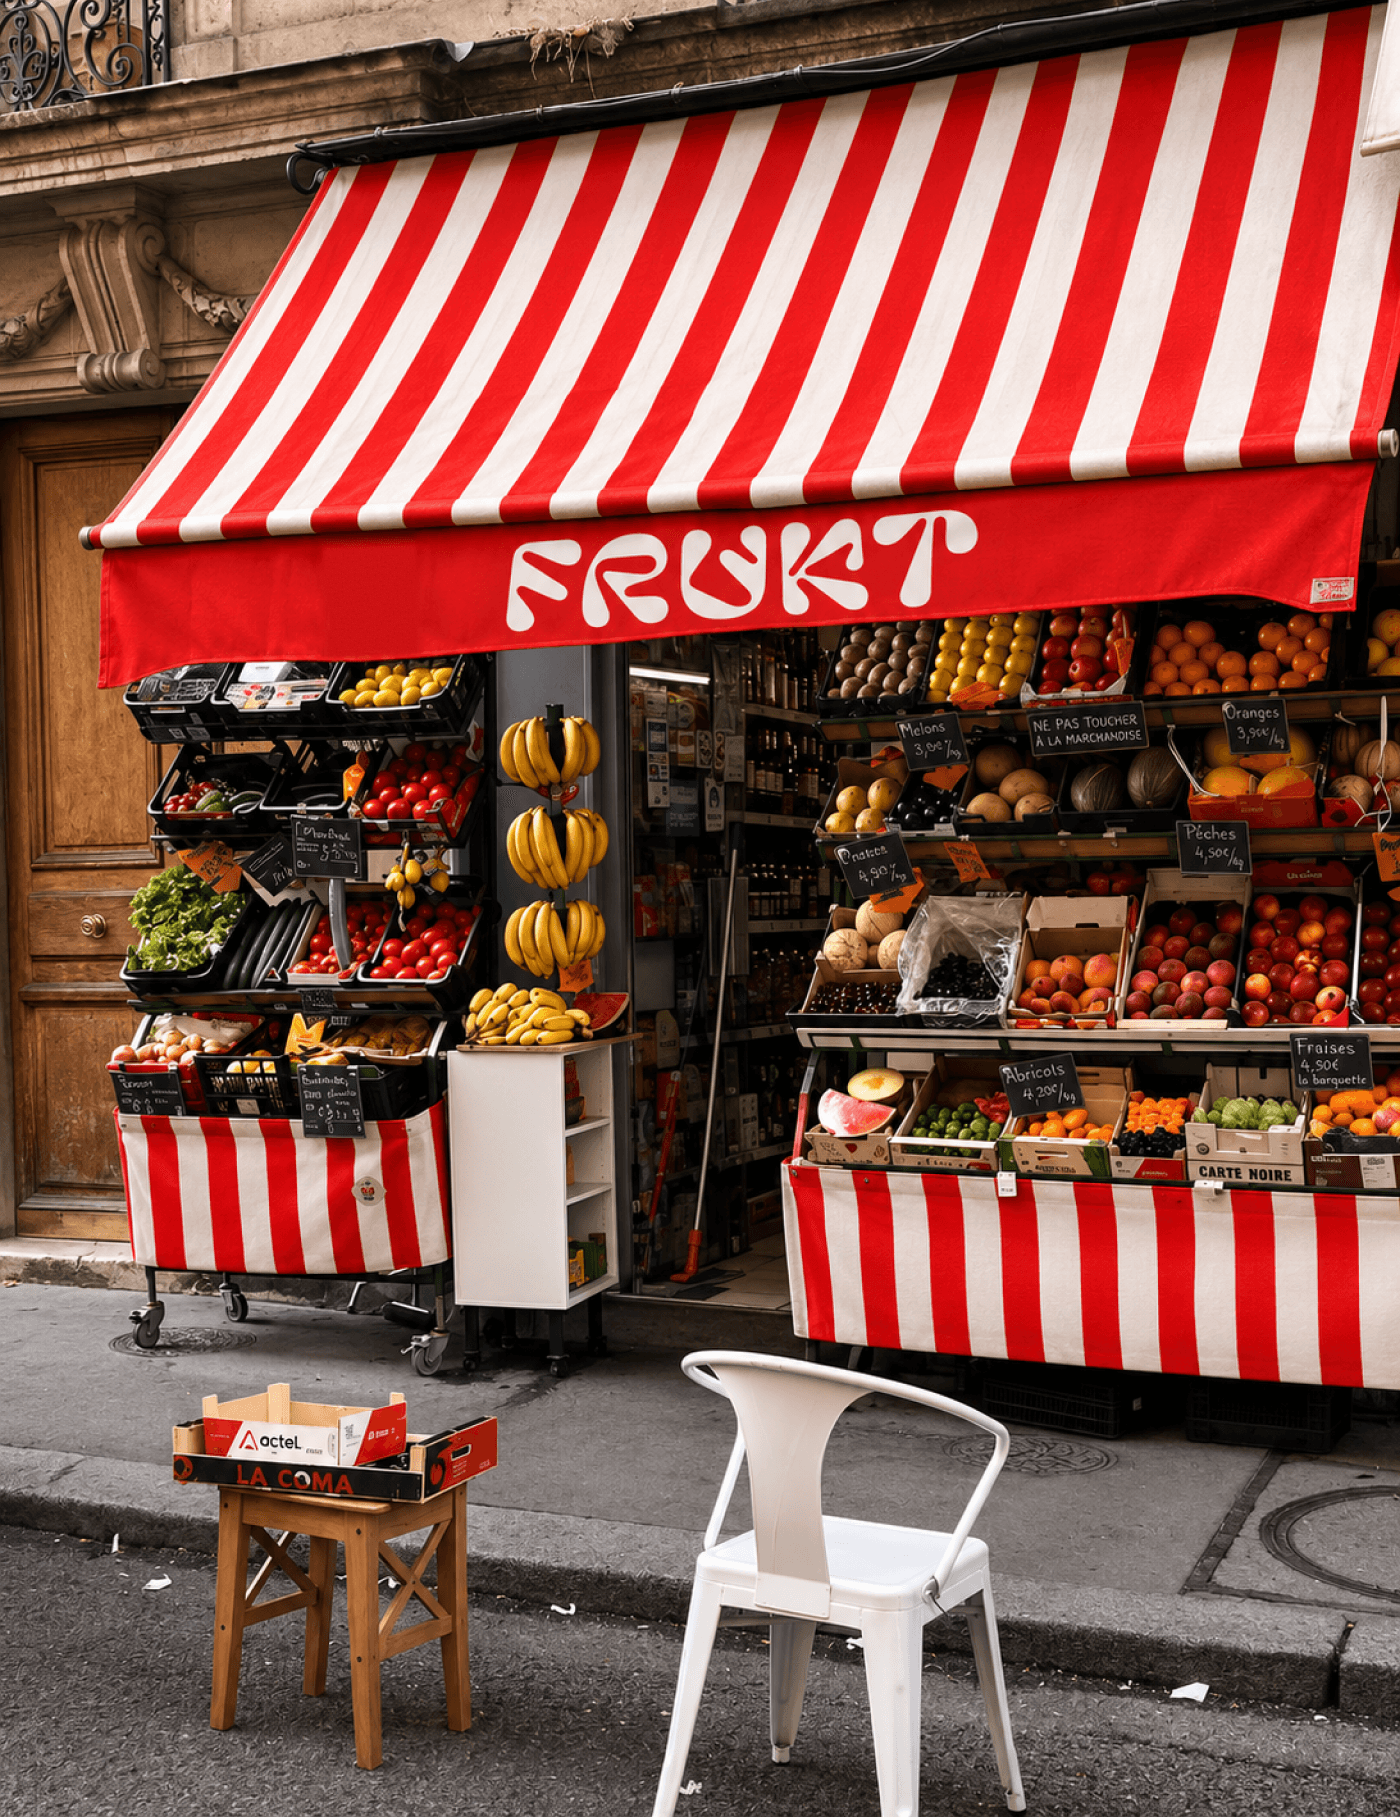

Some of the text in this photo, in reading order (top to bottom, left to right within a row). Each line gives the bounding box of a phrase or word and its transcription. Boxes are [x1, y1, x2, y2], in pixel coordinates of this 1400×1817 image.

[506, 510, 978, 632] FRUKT
[1225, 702, 1280, 723] Oranges
[898, 722, 946, 739] Melons
[1033, 714, 1138, 732] NE PAS TOUCHER
[1048, 734, 1063, 747] LA
[1066, 729, 1143, 746] MARCHANDISE
[1295, 1037, 1356, 1056] Fraises
[1300, 1058, 1340, 1073] 4,50€
[1199, 1165, 1293, 1182] CARTE NOIRE
[236, 1464, 354, 1495] LA COMA
